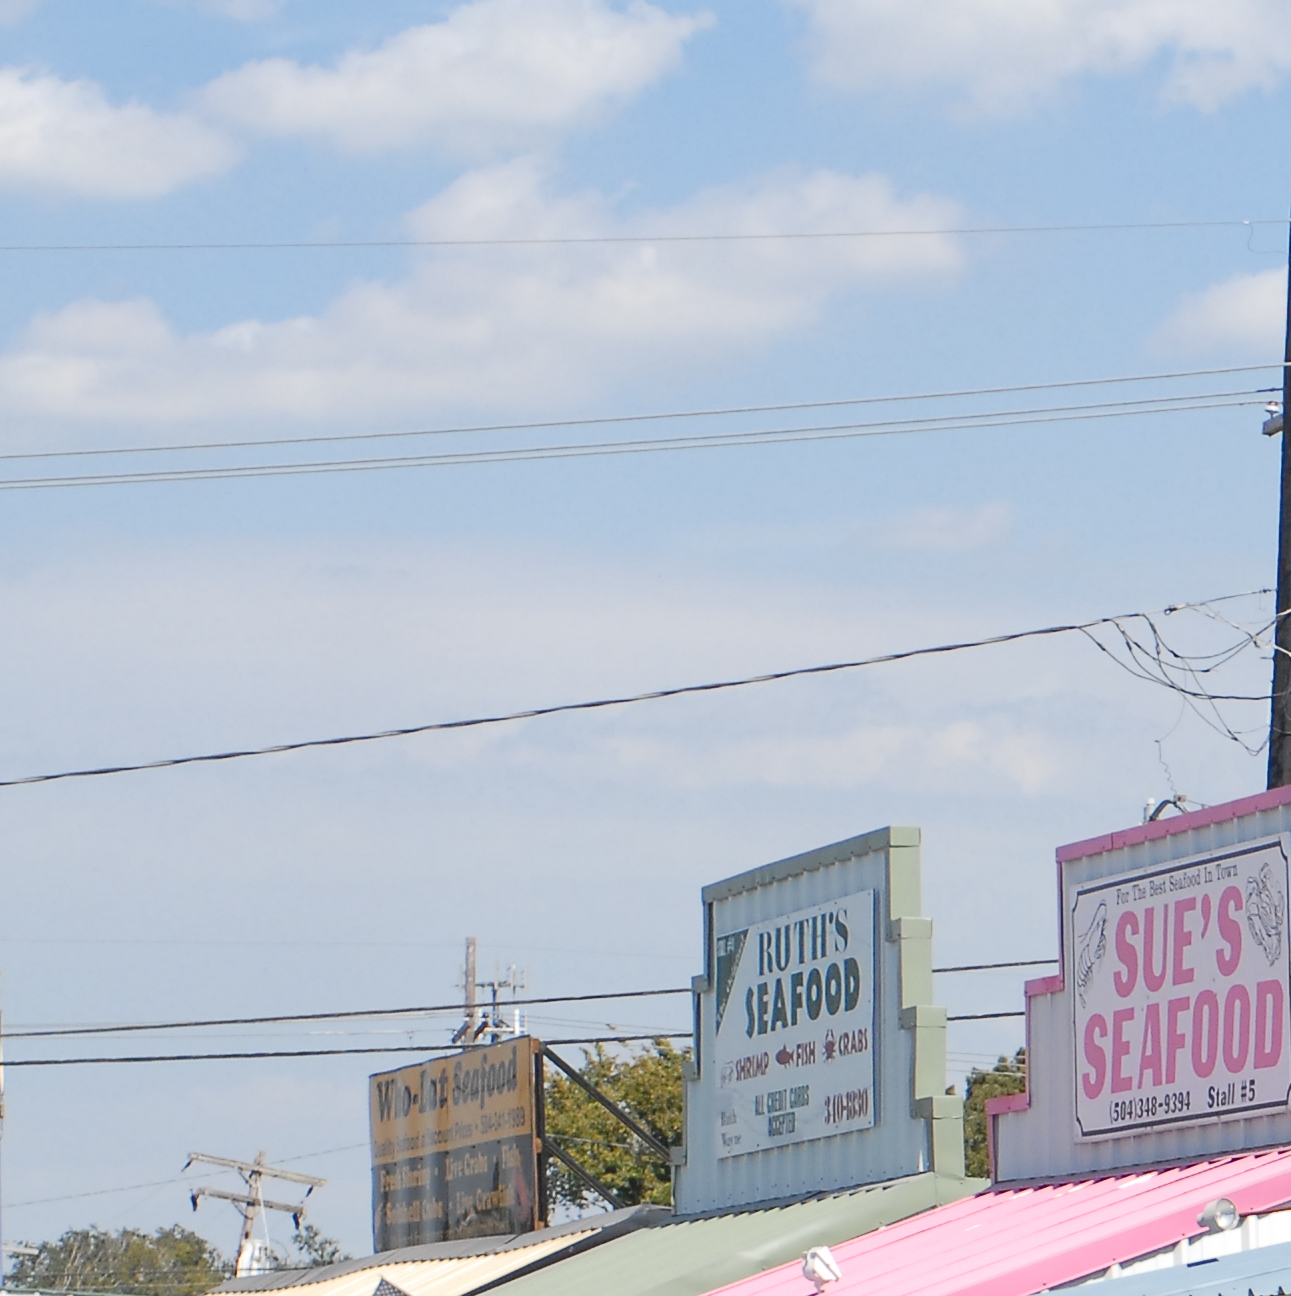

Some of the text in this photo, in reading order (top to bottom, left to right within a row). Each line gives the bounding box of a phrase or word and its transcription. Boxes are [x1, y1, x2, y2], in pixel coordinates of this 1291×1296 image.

[1116, 863, 1238, 906] For The Best Seafood In Town
[758, 908, 849, 976] RUTH'S
[1113, 886, 1243, 998] SUE'S
[745, 957, 860, 1039] SEAFOOD
[735, 1028, 868, 1082] SHRIMP FISH CRABS
[1082, 979, 1284, 1100] SEAFOOD
[453, 1047, 518, 1110] Seafood
[1109, 1079, 1256, 1125] (504)348-9394 Stall #5
